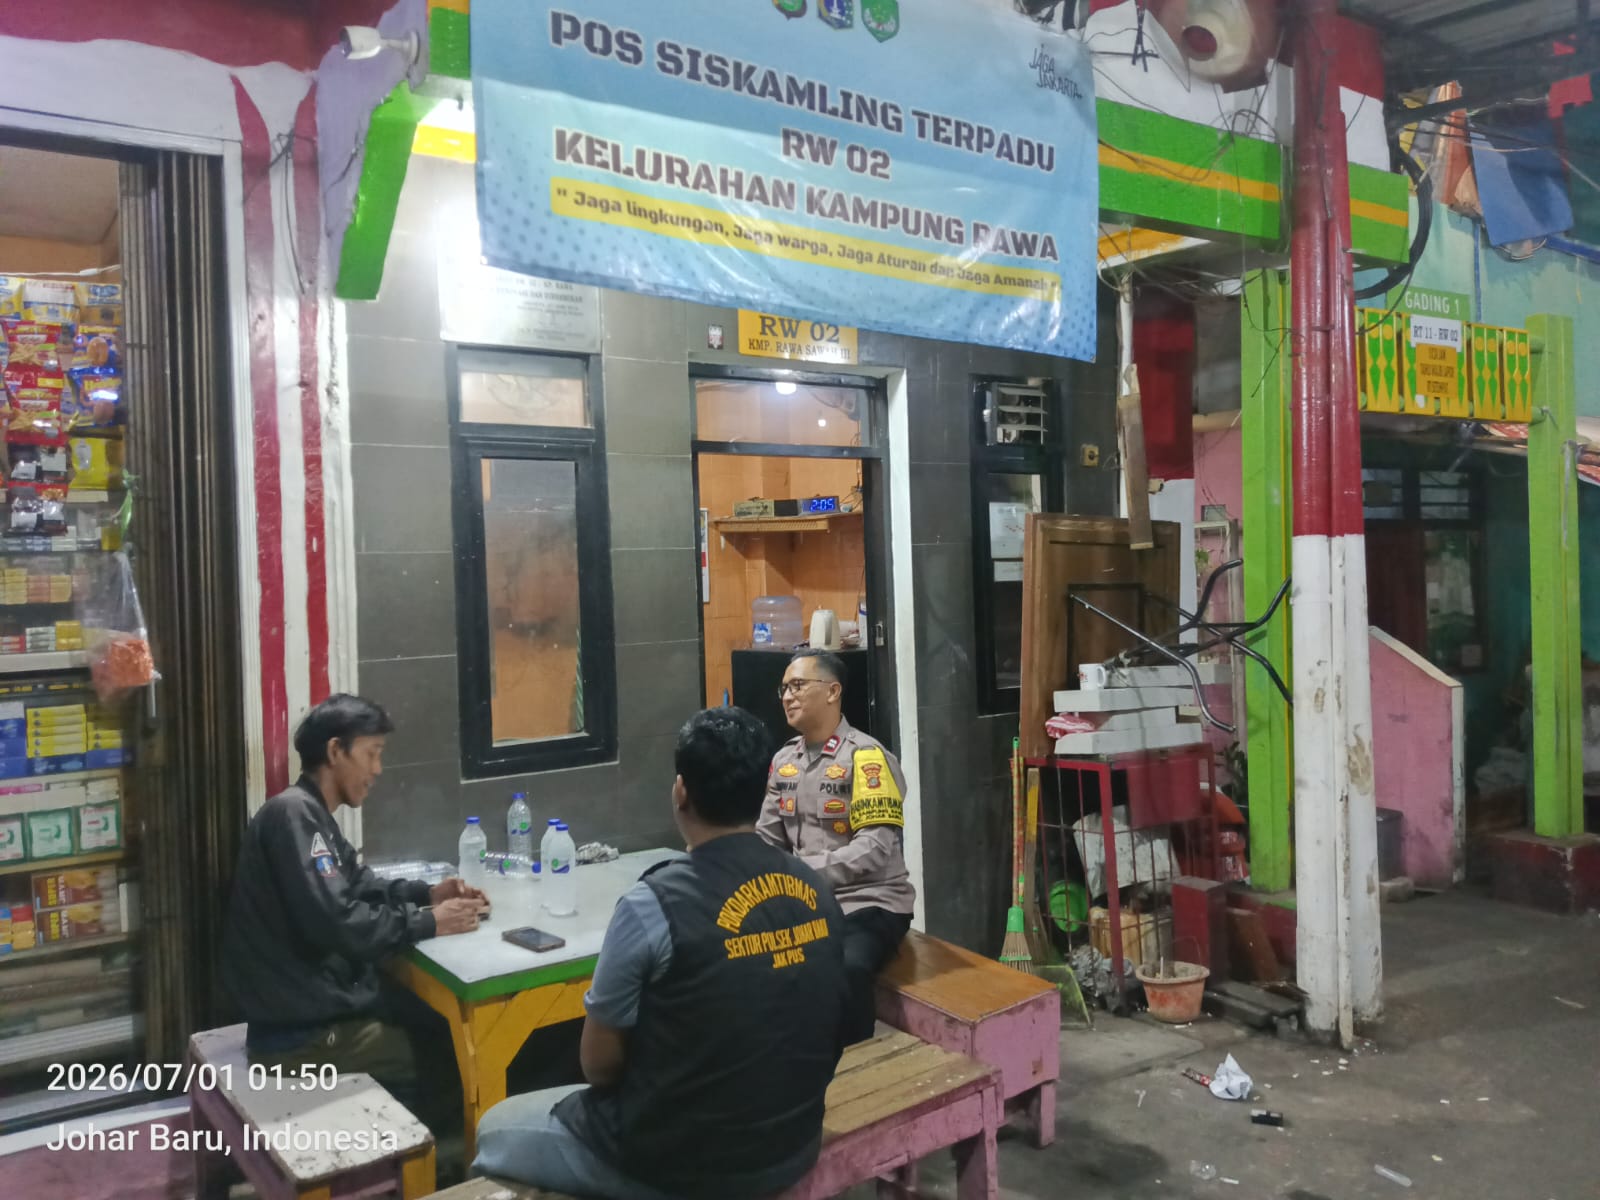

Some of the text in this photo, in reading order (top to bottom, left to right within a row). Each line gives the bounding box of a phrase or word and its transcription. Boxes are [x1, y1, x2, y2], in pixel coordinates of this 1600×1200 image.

[551, 11, 1055, 172] POS SISKAMLING TERPADU
[782, 128, 890, 180] RW 02
[555, 129, 1059, 262] KELURAHAN KAMPUNG RAWA
[574, 191, 622, 214] Jaga
[626, 200, 729, 237] lingkungan,
[733, 222, 773, 246] Jaga
[778, 233, 833, 258] warga,
[837, 244, 873, 266] Jaga
[877, 252, 926, 274] Aturan
[930, 261, 954, 278] dan
[957, 267, 990, 285] Jaga
[1405, 291, 1460, 316] GADING 1
[759, 316, 840, 344] RW 02
[1413, 325, 1422, 338] RT
[1438, 328, 1449, 340] RW
[776, 341, 802, 354] RAWA
[805, 344, 837, 357] SAW
[810, 498, 834, 512] 2:05
[761, 928, 793, 952] POLSEK
[786, 947, 805, 966] PUS
